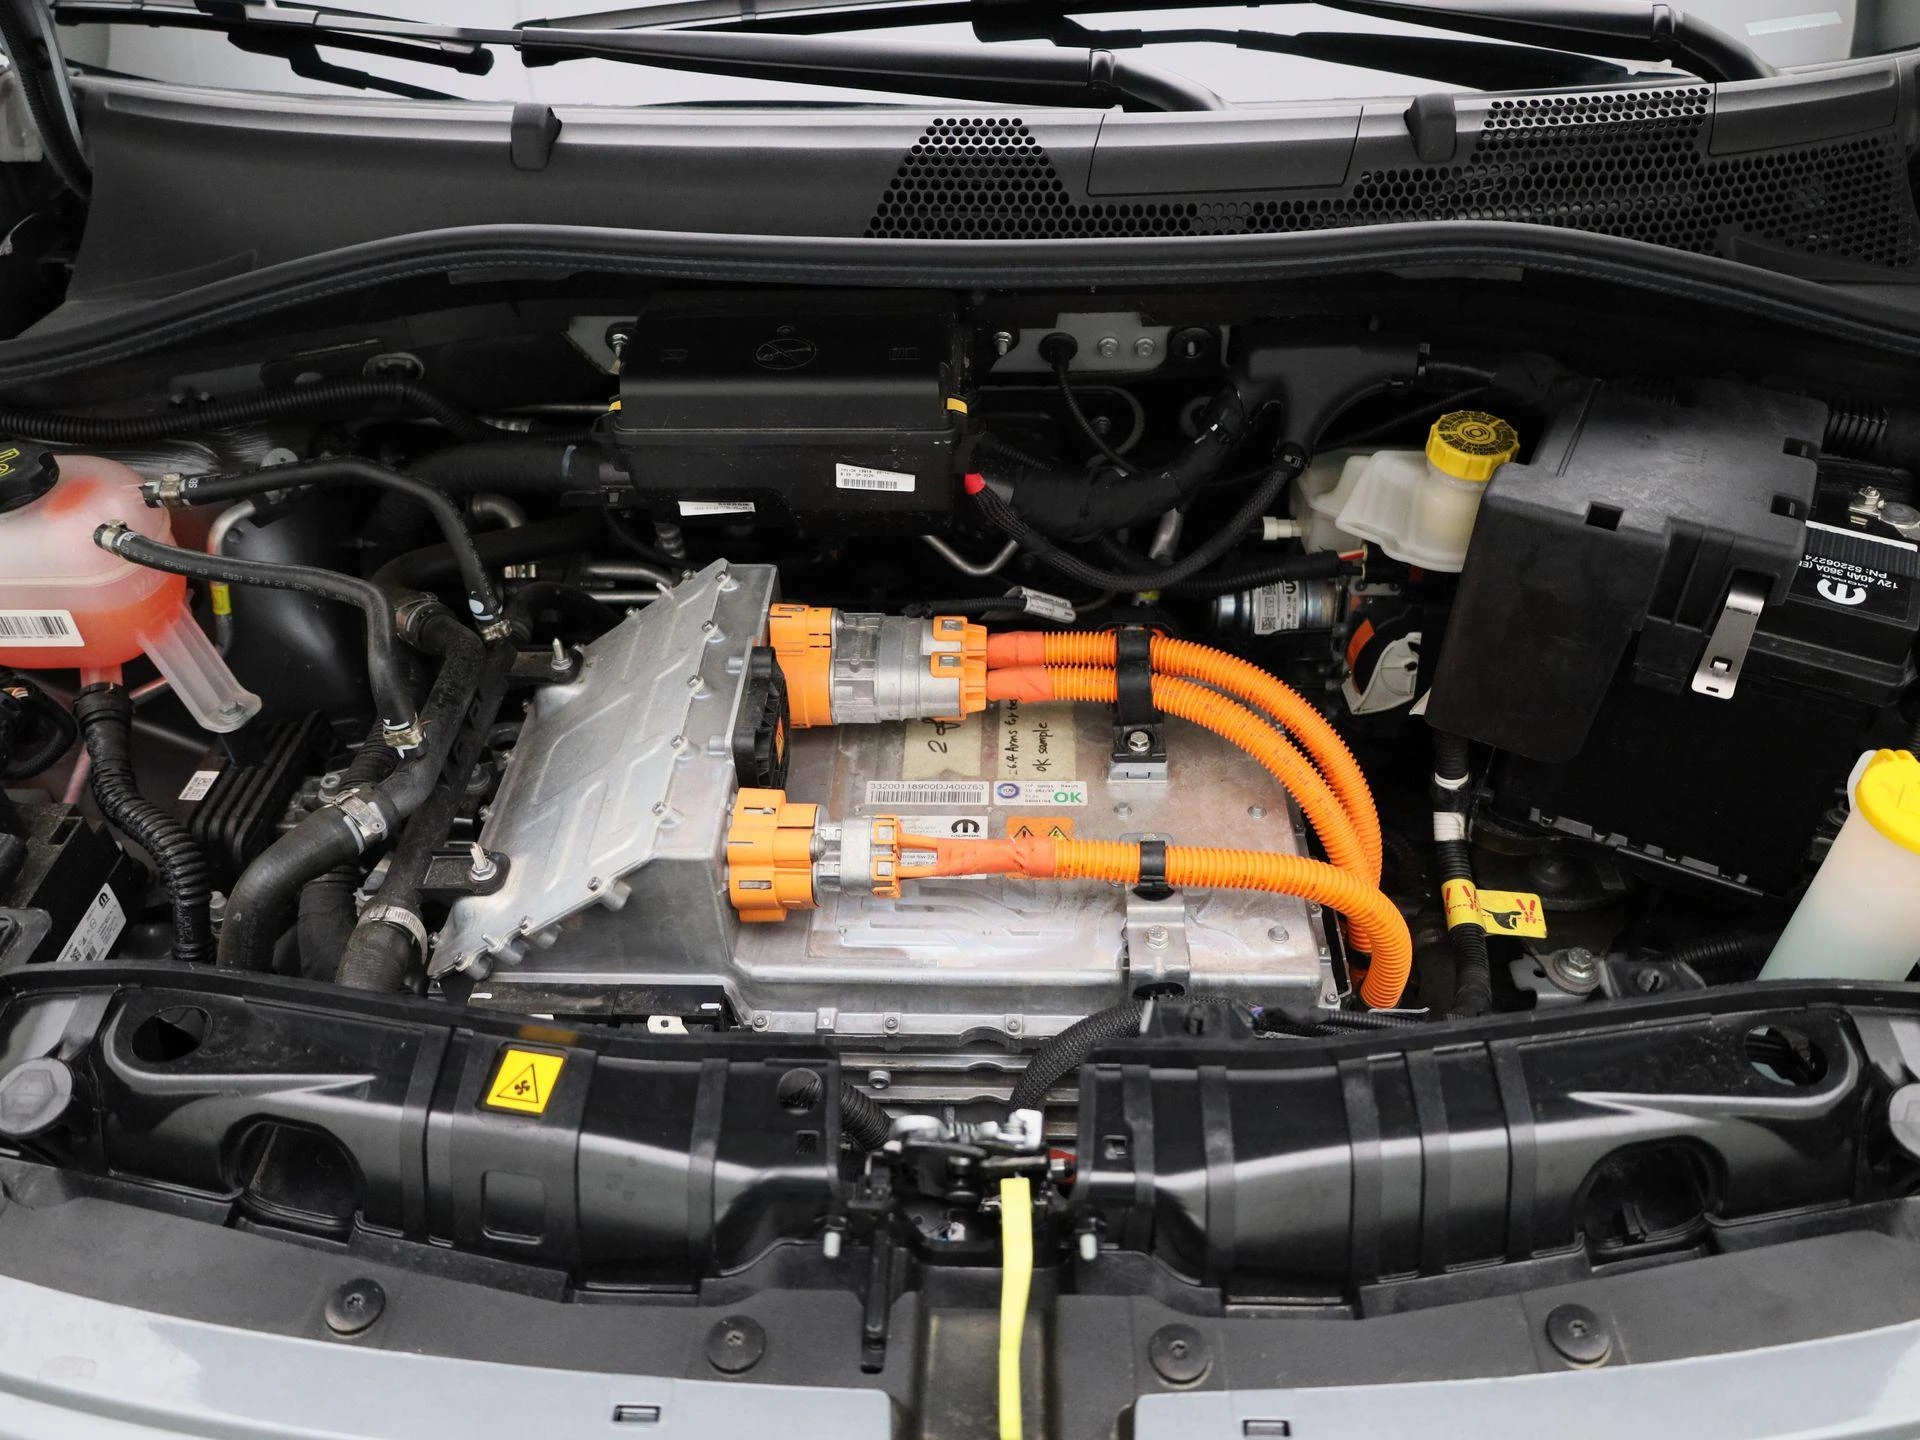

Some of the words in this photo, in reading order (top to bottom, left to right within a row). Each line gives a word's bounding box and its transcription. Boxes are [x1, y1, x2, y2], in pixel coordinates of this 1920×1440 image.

[1805, 554, 1862, 573] 52206274
[1816, 563, 1844, 576] 360A
[1847, 571, 1875, 583] 40Ah
[1866, 568, 1887, 579] PN:
[1877, 579, 1898, 589] 12V
[1032, 722, 1053, 754] sample
[1053, 791, 1082, 803] OK
